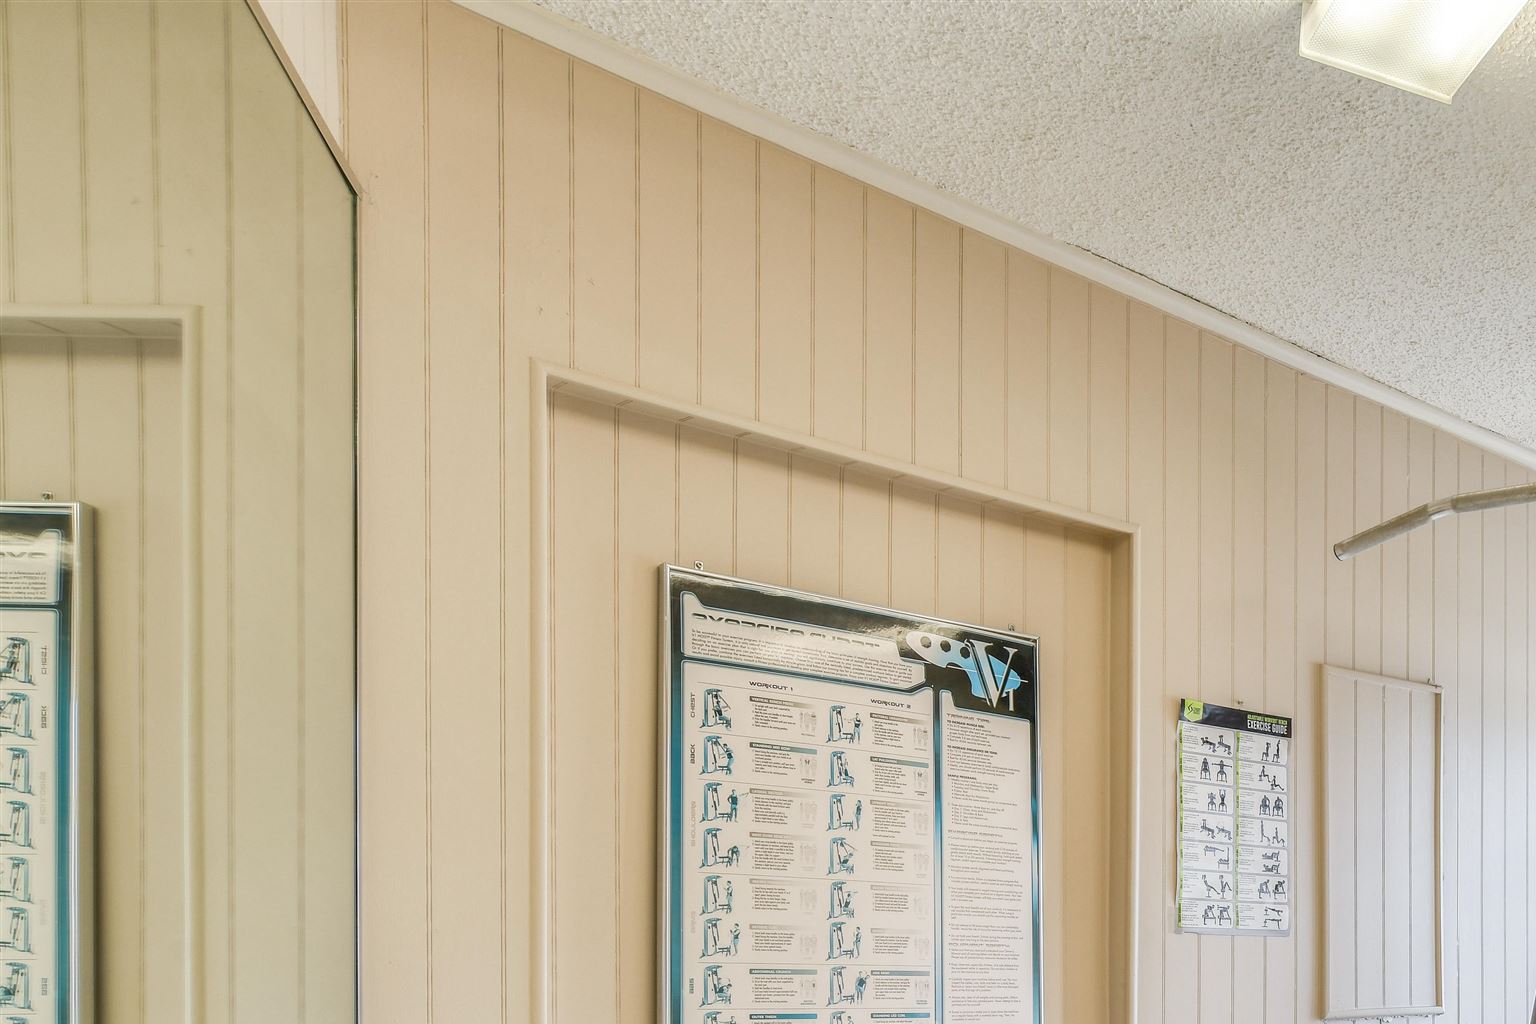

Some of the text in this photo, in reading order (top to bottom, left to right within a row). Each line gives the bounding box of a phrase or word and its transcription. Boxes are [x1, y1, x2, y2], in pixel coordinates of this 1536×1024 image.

[748, 681, 788, 691] WORKOUT
[870, 699, 904, 708] WORKOUT
[1247, 720, 1287, 734] EXERCISE GUIDE
